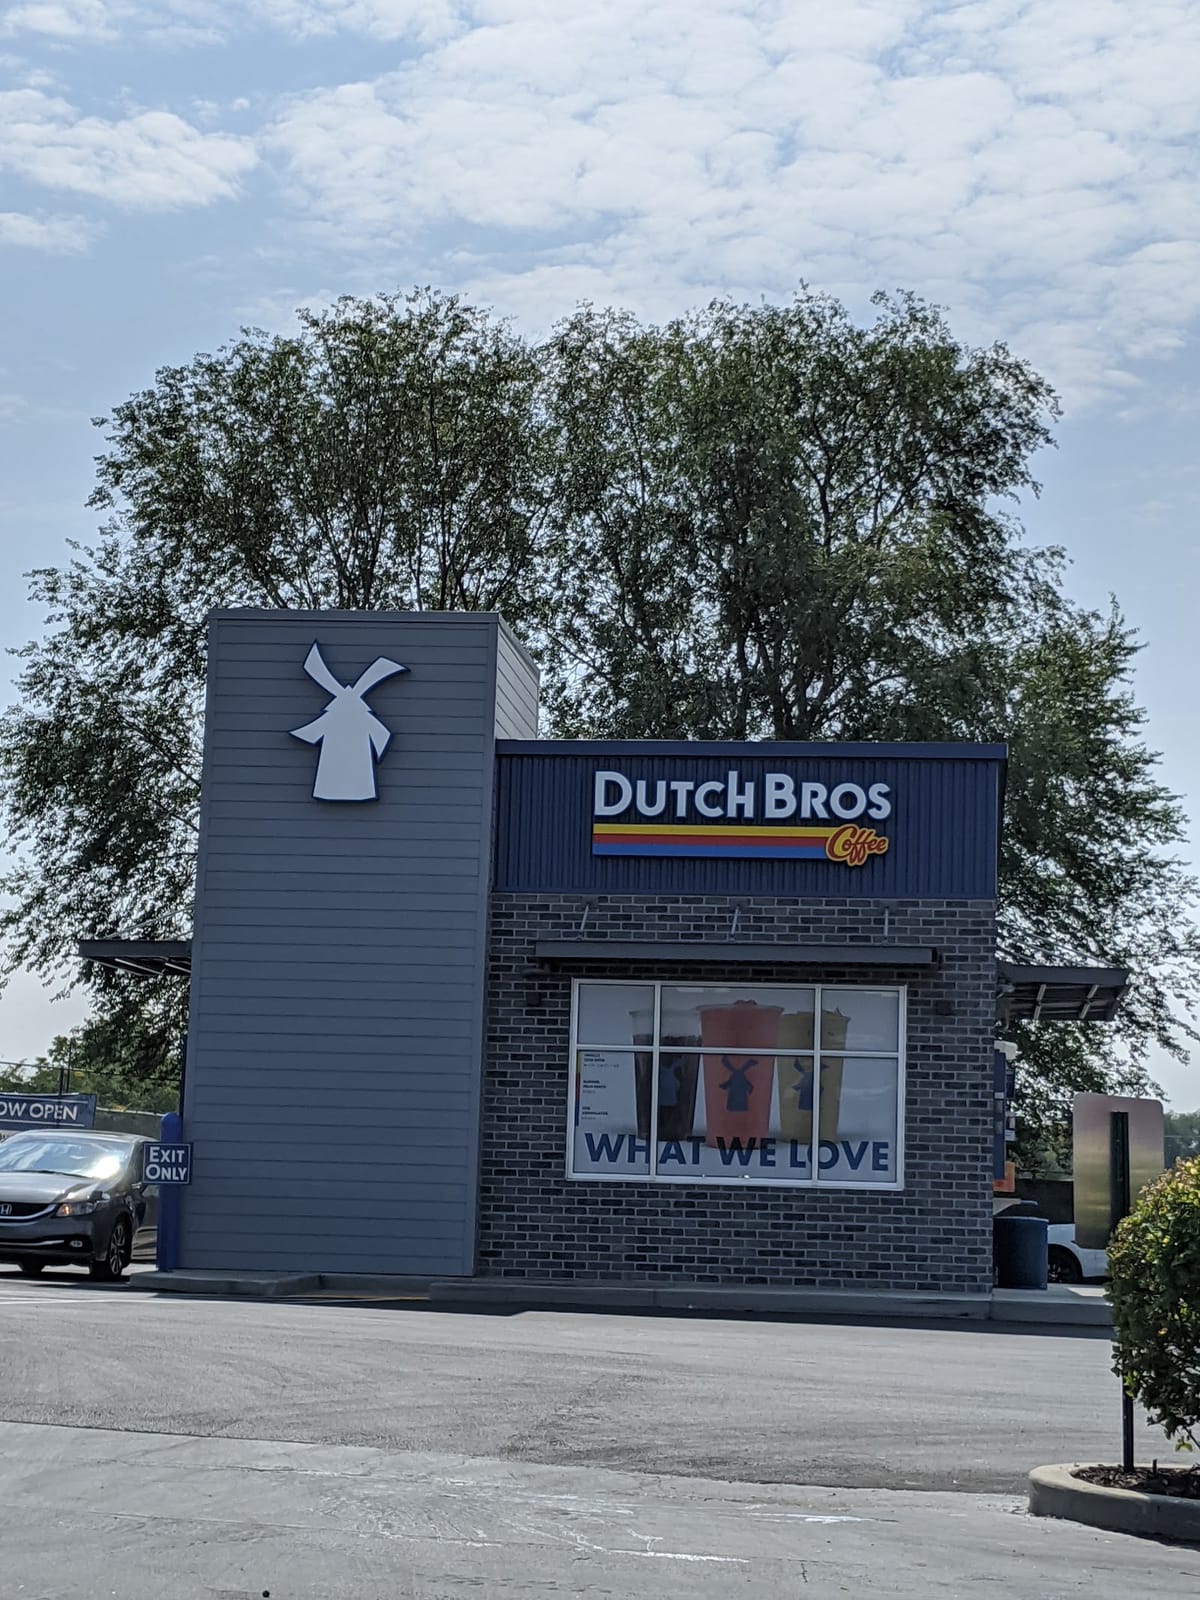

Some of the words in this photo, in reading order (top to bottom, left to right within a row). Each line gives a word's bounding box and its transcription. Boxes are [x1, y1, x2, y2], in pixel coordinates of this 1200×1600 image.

[765, 773, 891, 819] BROS
[826, 824, 888, 866] Coffee
[29, 1103, 78, 1120] OPEN
[149, 1146, 185, 1163] EXIT
[584, 1132, 706, 1165] WHAT
[716, 1136, 776, 1167] WE
[789, 1138, 889, 1171] LOVE
[145, 1164, 187, 1181] ONLY
